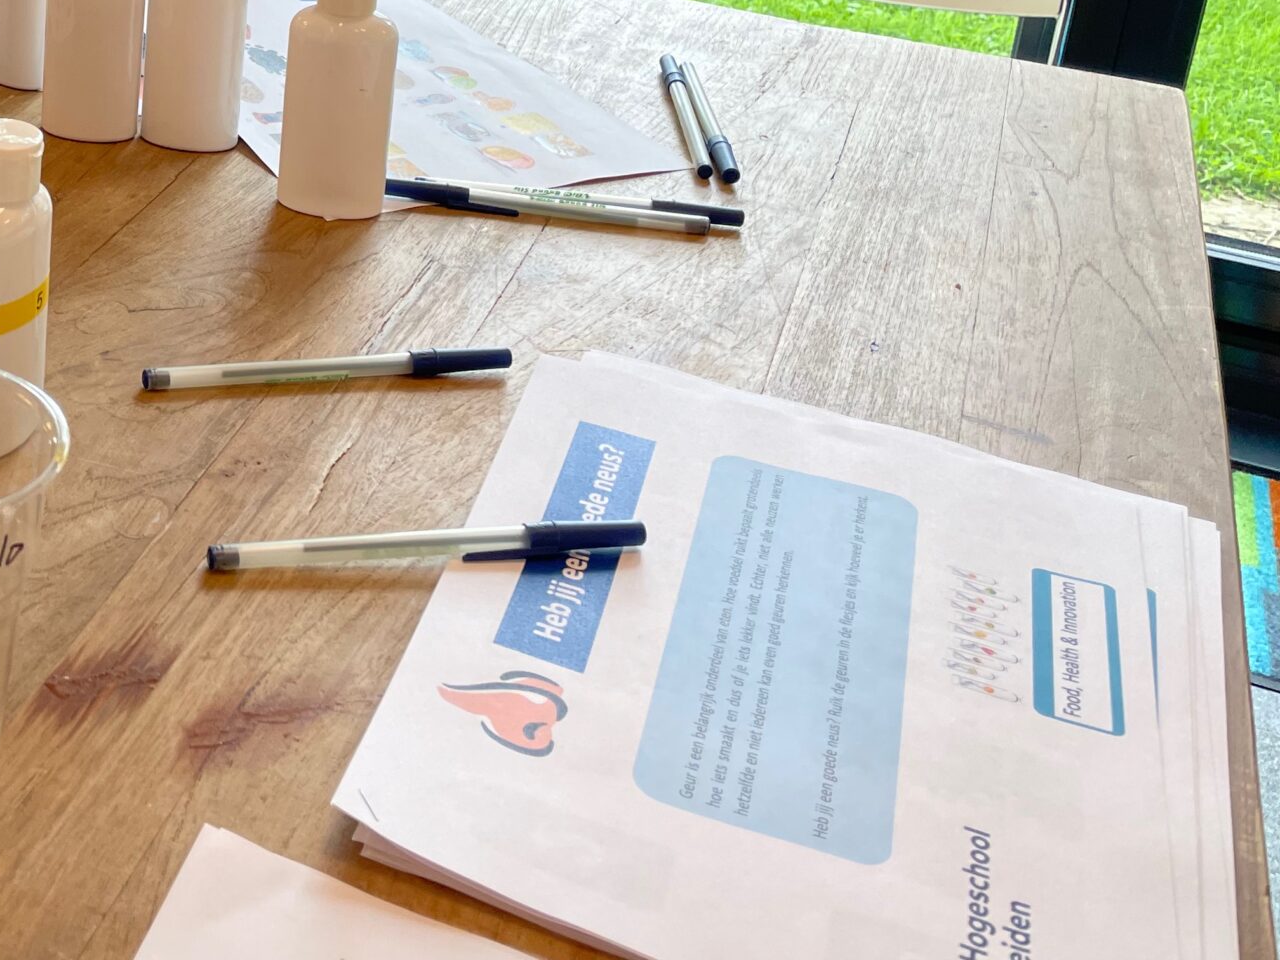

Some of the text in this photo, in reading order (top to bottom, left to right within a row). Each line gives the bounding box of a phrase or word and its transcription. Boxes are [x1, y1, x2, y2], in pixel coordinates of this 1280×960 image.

[36, 292, 43, 310] 5
[533, 443, 625, 642] Heb jij een ede neus?
[1060, 581, 1083, 718] Food, Health & Innovation
[1001, 901, 1031, 960] eiden
